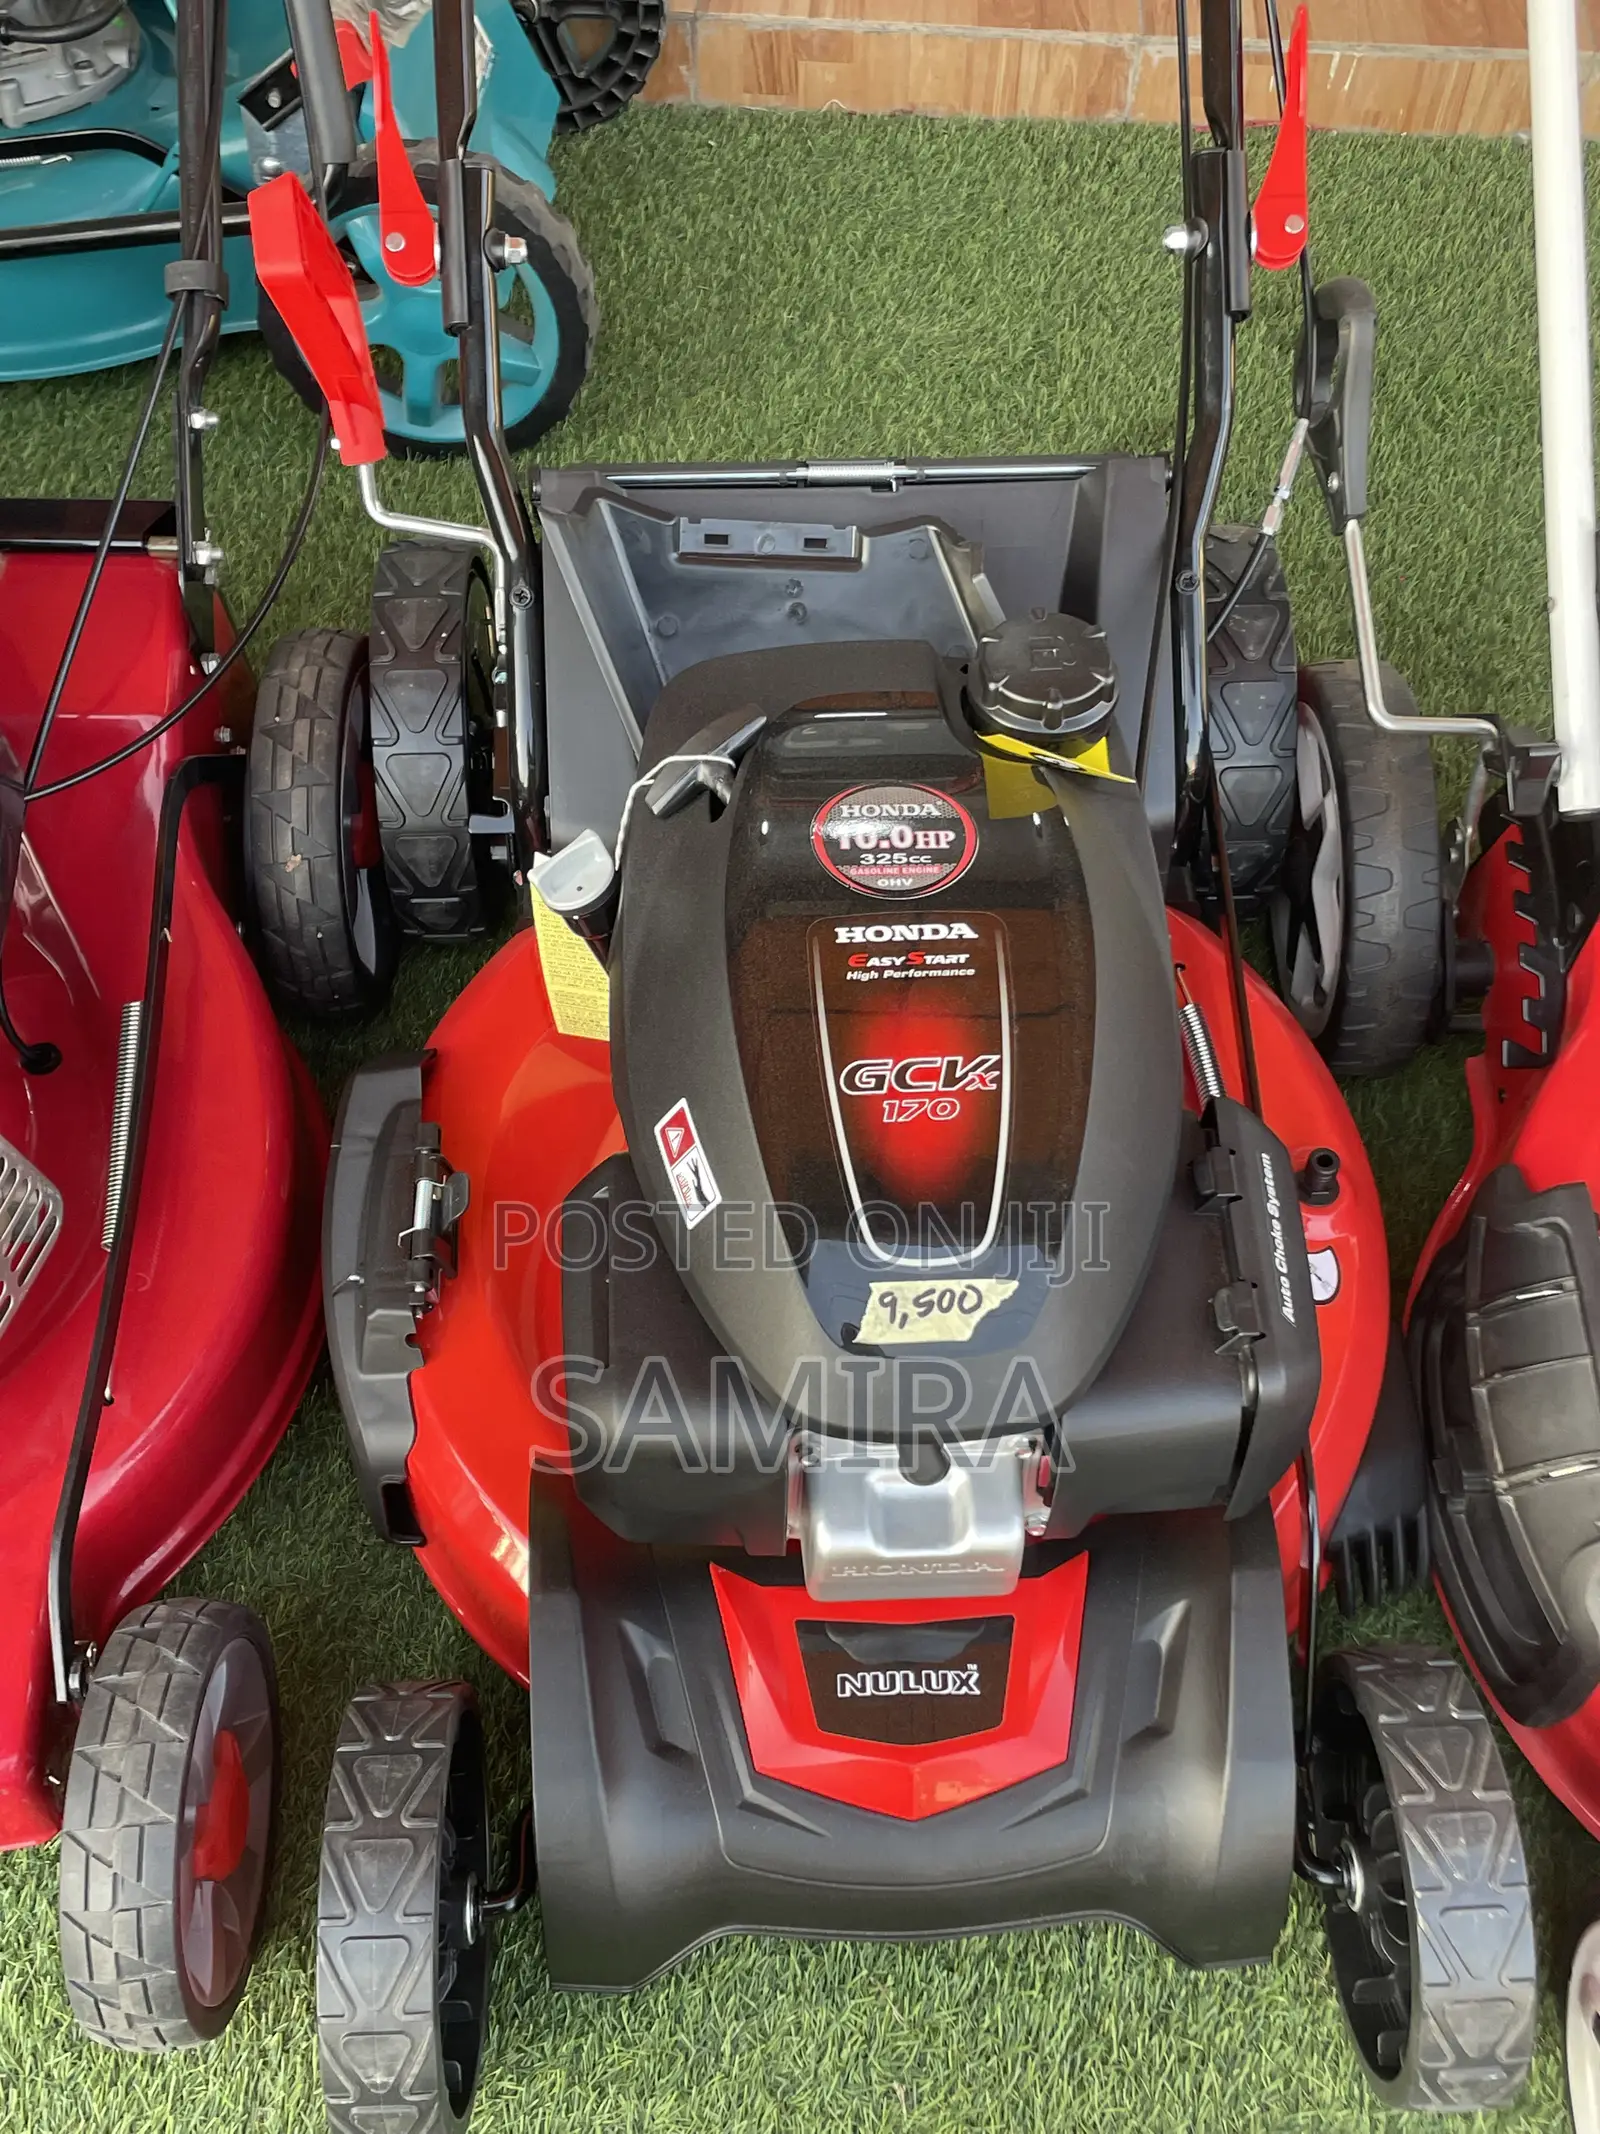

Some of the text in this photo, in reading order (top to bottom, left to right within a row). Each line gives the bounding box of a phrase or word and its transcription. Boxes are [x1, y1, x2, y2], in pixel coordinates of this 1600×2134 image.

[840, 802, 941, 818] HONDA
[850, 865, 940, 875] GASOLINE ENGINE
[877, 878, 913, 887] OHV
[834, 922, 979, 944] HONDA
[846, 967, 976, 982] High Performance
[882, 1097, 961, 1123] 170
[1260, 1152, 1296, 1326] Auto Choke System
[878, 1284, 983, 1329] 9,500
